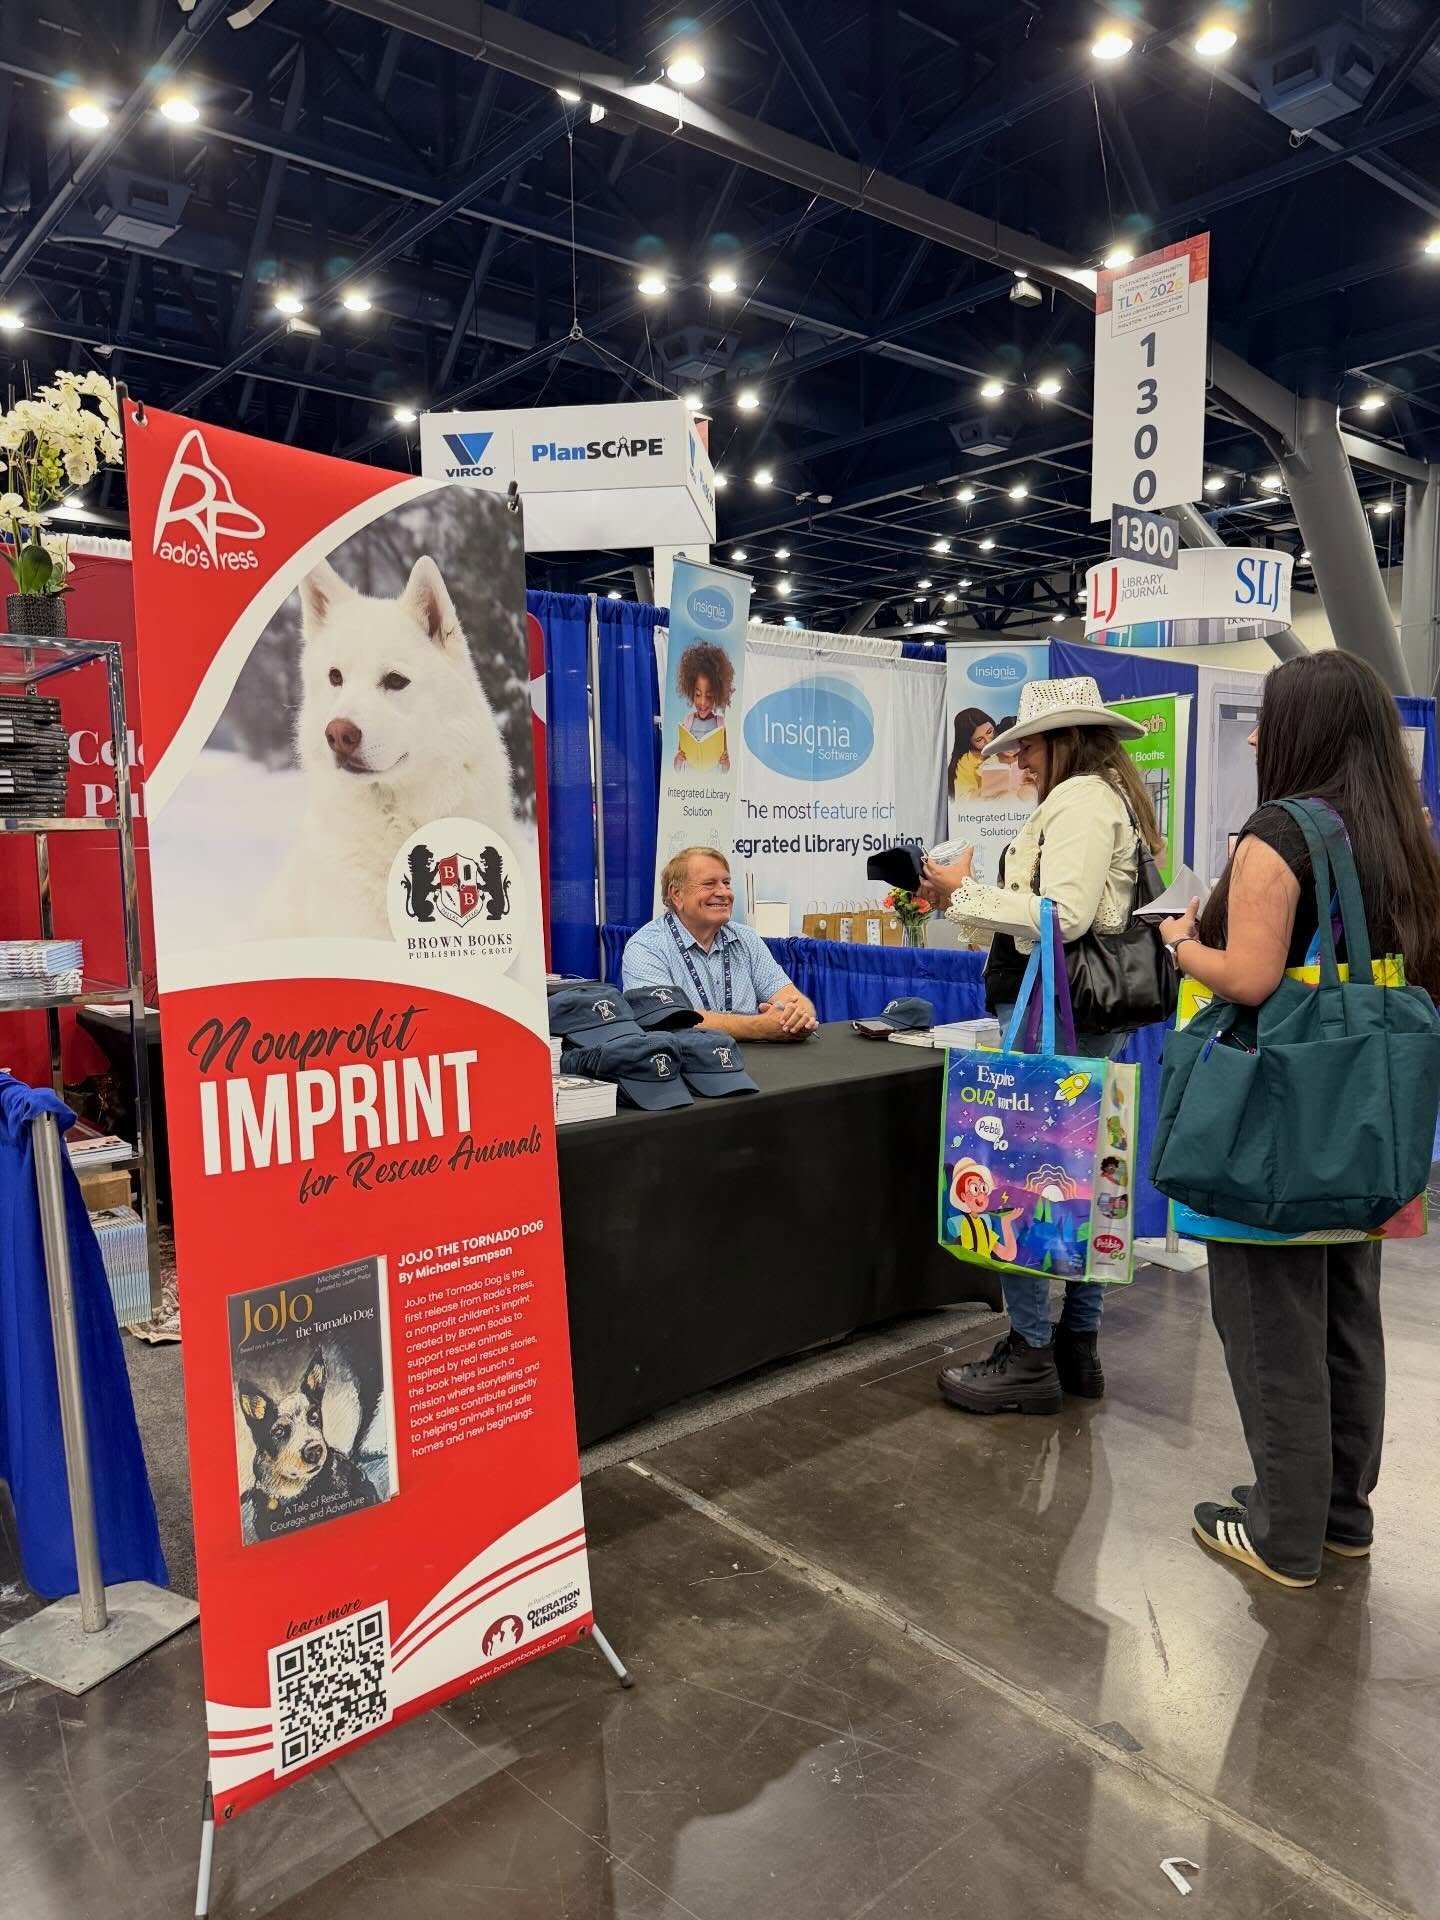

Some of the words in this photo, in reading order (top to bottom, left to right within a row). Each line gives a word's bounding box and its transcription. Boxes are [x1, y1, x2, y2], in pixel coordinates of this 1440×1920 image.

[1117, 292, 1143, 310] TLA
[1131, 331, 1158, 505] 1300
[445, 466, 494, 478] VIRCO
[1117, 515, 1174, 559] 1300
[1092, 566, 1119, 624] LJ
[1120, 585, 1169, 601] JOURNAL
[1122, 573, 1165, 588] LIBRARY
[1235, 557, 1283, 613] SLJ
[693, 598, 726, 618] Insignia
[975, 666, 1016, 679] Insignia
[764, 713, 850, 754] Insignia
[818, 748, 858, 761] Software
[1135, 750, 1165, 762] Booths
[667, 787, 704, 800] Integrated
[705, 789, 730, 802] Library
[682, 806, 712, 817] Solution
[740, 800, 768, 819] he
[773, 801, 812, 820] most
[812, 800, 868, 820] feature
[958, 813, 1006, 824] Integrated
[980, 828, 1018, 837] Solution
[731, 835, 801, 859] egrated
[804, 834, 860, 857] Library
[407, 936, 462, 950] BROWN
[468, 934, 513, 947] BOOKS
[408, 949, 476, 960] PUBLISHING
[481, 947, 513, 956] GROUP
[187, 1004, 429, 1074] Nonprofit
[199, 1049, 479, 1177] IMPRINT
[961, 1087, 996, 1107] OUR
[299, 1167, 339, 1204] for
[346, 1150, 442, 1191] Rescue
[447, 1124, 543, 1172] Animals
[398, 1248, 434, 1268] JOJO
[436, 1242, 460, 1257] THE
[462, 1227, 520, 1251] TORNADO
[521, 1220, 544, 1236] DOG
[398, 1271, 414, 1284] By
[416, 1258, 460, 1279] Michael
[462, 1246, 512, 1267] Sampson
[404, 1296, 426, 1309] JoJo
[428, 1290, 444, 1302] the
[445, 1280, 483, 1299] Tornado
[484, 1276, 502, 1288] Dog
[504, 1272, 510, 1281] is
[512, 1268, 525, 1280] the
[404, 1312, 422, 1324] first
[424, 1302, 458, 1319] release
[460, 1295, 481, 1308] from
[483, 1287, 512, 1302] Rado's
[512, 1280, 535, 1294] Press,
[237, 1290, 313, 1347] JoJo
[296, 1326, 312, 1338] the
[314, 1313, 352, 1333] Tornado
[354, 1307, 374, 1320] Dog
[406, 1330, 412, 1338] a
[414, 1316, 456, 1336] nonprofit
[458, 1304, 500, 1324] children's
[501, 1294, 530, 1312] imprint
[406, 1335, 442, 1354] created
[445, 1332, 457, 1342] by
[458, 1323, 486, 1338] Brown
[488, 1314, 513, 1329] Books
[514, 1312, 522, 1320] to
[407, 1350, 443, 1369] support
[445, 1342, 476, 1356] rescue
[478, 1329, 514, 1347] animals.
[408, 1366, 446, 1384] Inspired
[447, 1361, 459, 1372] by
[460, 1354, 478, 1366] real
[480, 1346, 508, 1361] rescue
[409, 1388, 424, 1398] the
[426, 1378, 449, 1392] book
[451, 1370, 476, 1384] helps
[478, 1360, 507, 1376] launch
[410, 1395, 446, 1414] mission
[447, 1386, 475, 1400] where
[477, 1368, 522, 1391] storytelling
[524, 1361, 540, 1374] and
[410, 1413, 434, 1428] book
[436, 1405, 460, 1420] sales
[461, 1388, 506, 1410] contribute
[508, 1377, 537, 1394] directly
[411, 1434, 421, 1442] to
[422, 1420, 458, 1439] helping
[460, 1408, 494, 1426] animals
[496, 1401, 512, 1413] find
[514, 1394, 532, 1406] safe
[412, 1440, 444, 1458] homes
[446, 1432, 464, 1445] and
[466, 1425, 485, 1438] new
[486, 1407, 534, 1430] beginnings.
[284, 1506, 292, 1516] A
[292, 1502, 310, 1513] Tale
[310, 1496, 320, 1508] of
[308, 1508, 324, 1520] and
[326, 1496, 365, 1516] Adventure
[286, 1615, 324, 1640] learn
[326, 1599, 361, 1620] more
[527, 1588, 580, 1621] OPERATION
[531, 1599, 578, 1630] KINDNESS
[469, 1634, 567, 1685] www.brownbooks.com
